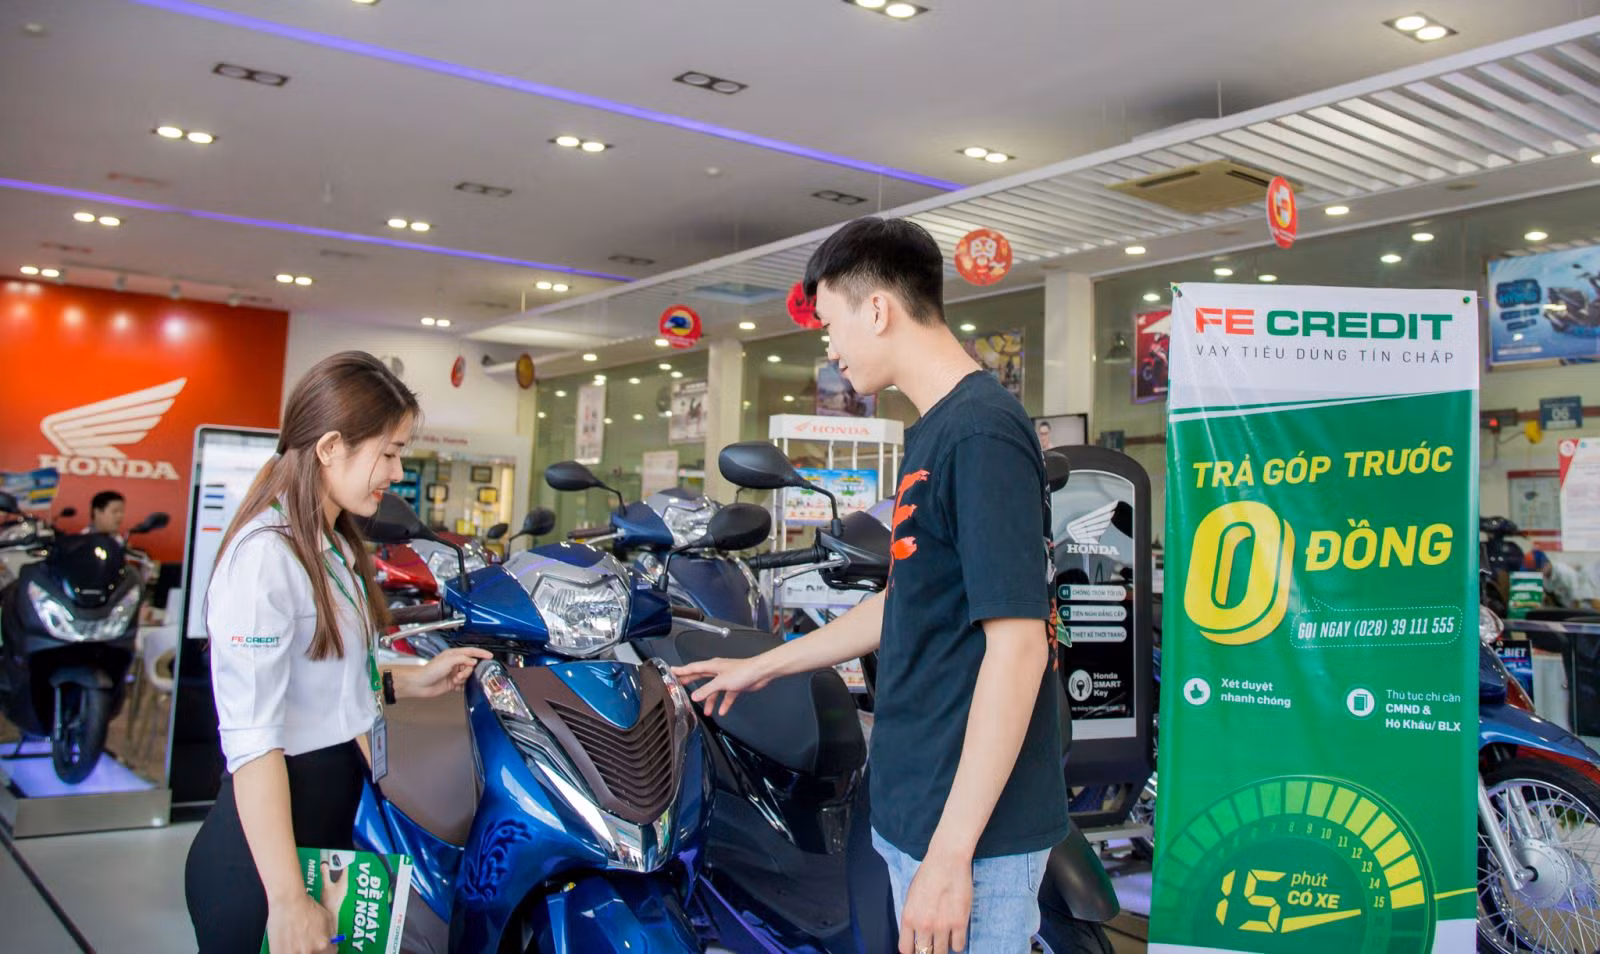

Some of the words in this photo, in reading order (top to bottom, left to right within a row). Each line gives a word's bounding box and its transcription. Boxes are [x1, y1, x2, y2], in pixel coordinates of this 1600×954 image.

[1196, 307, 1254, 335] FE
[1267, 310, 1453, 341] CREDIT
[1196, 345, 1229, 357] VAY
[1296, 346, 1347, 360] DÙNG
[1359, 347, 1391, 362] TÍN
[812, 424, 871, 437] HONDA
[38, 454, 180, 480] HONDA
[1192, 453, 1255, 489] TRẢ
[1262, 450, 1332, 486] GÓP
[1344, 440, 1454, 478] TRƯỚC
[1066, 543, 1120, 555] HONDA
[1305, 518, 1454, 571] ĐỒNG
[1183, 500, 1296, 646] 0
[1320, 620, 1351, 638] NGAY
[1354, 618, 1388, 638] (028)
[1391, 618, 1406, 636] 39
[1409, 617, 1428, 635] 111
[1432, 616, 1454, 634] 555
[1093, 672, 1118, 680] Honda
[1093, 680, 1122, 688] SMART
[1221, 677, 1240, 689] Xét
[1241, 679, 1273, 692] duyệt
[1093, 690, 1108, 698] Key
[1221, 692, 1255, 703] nhanh
[1257, 694, 1291, 708] chóng
[1385, 703, 1420, 714] CMND
[1422, 705, 1431, 715] &
[1438, 721, 1461, 732] BLX
[1288, 821, 1295, 833] 8
[1306, 822, 1313, 834] 9
[1320, 827, 1332, 839] 10
[1337, 835, 1348, 847] 11
[1351, 847, 1363, 859] 12
[1361, 861, 1373, 873] 13
[355, 862, 370, 898] VỌT
[1290, 871, 1328, 887] phút
[1369, 877, 1381, 889] 14
[1216, 869, 1287, 933] 15
[1287, 888, 1313, 906] CÓ
[1314, 893, 1341, 909] XE
[1373, 895, 1385, 908] 15
[351, 900, 367, 952] NGAY
